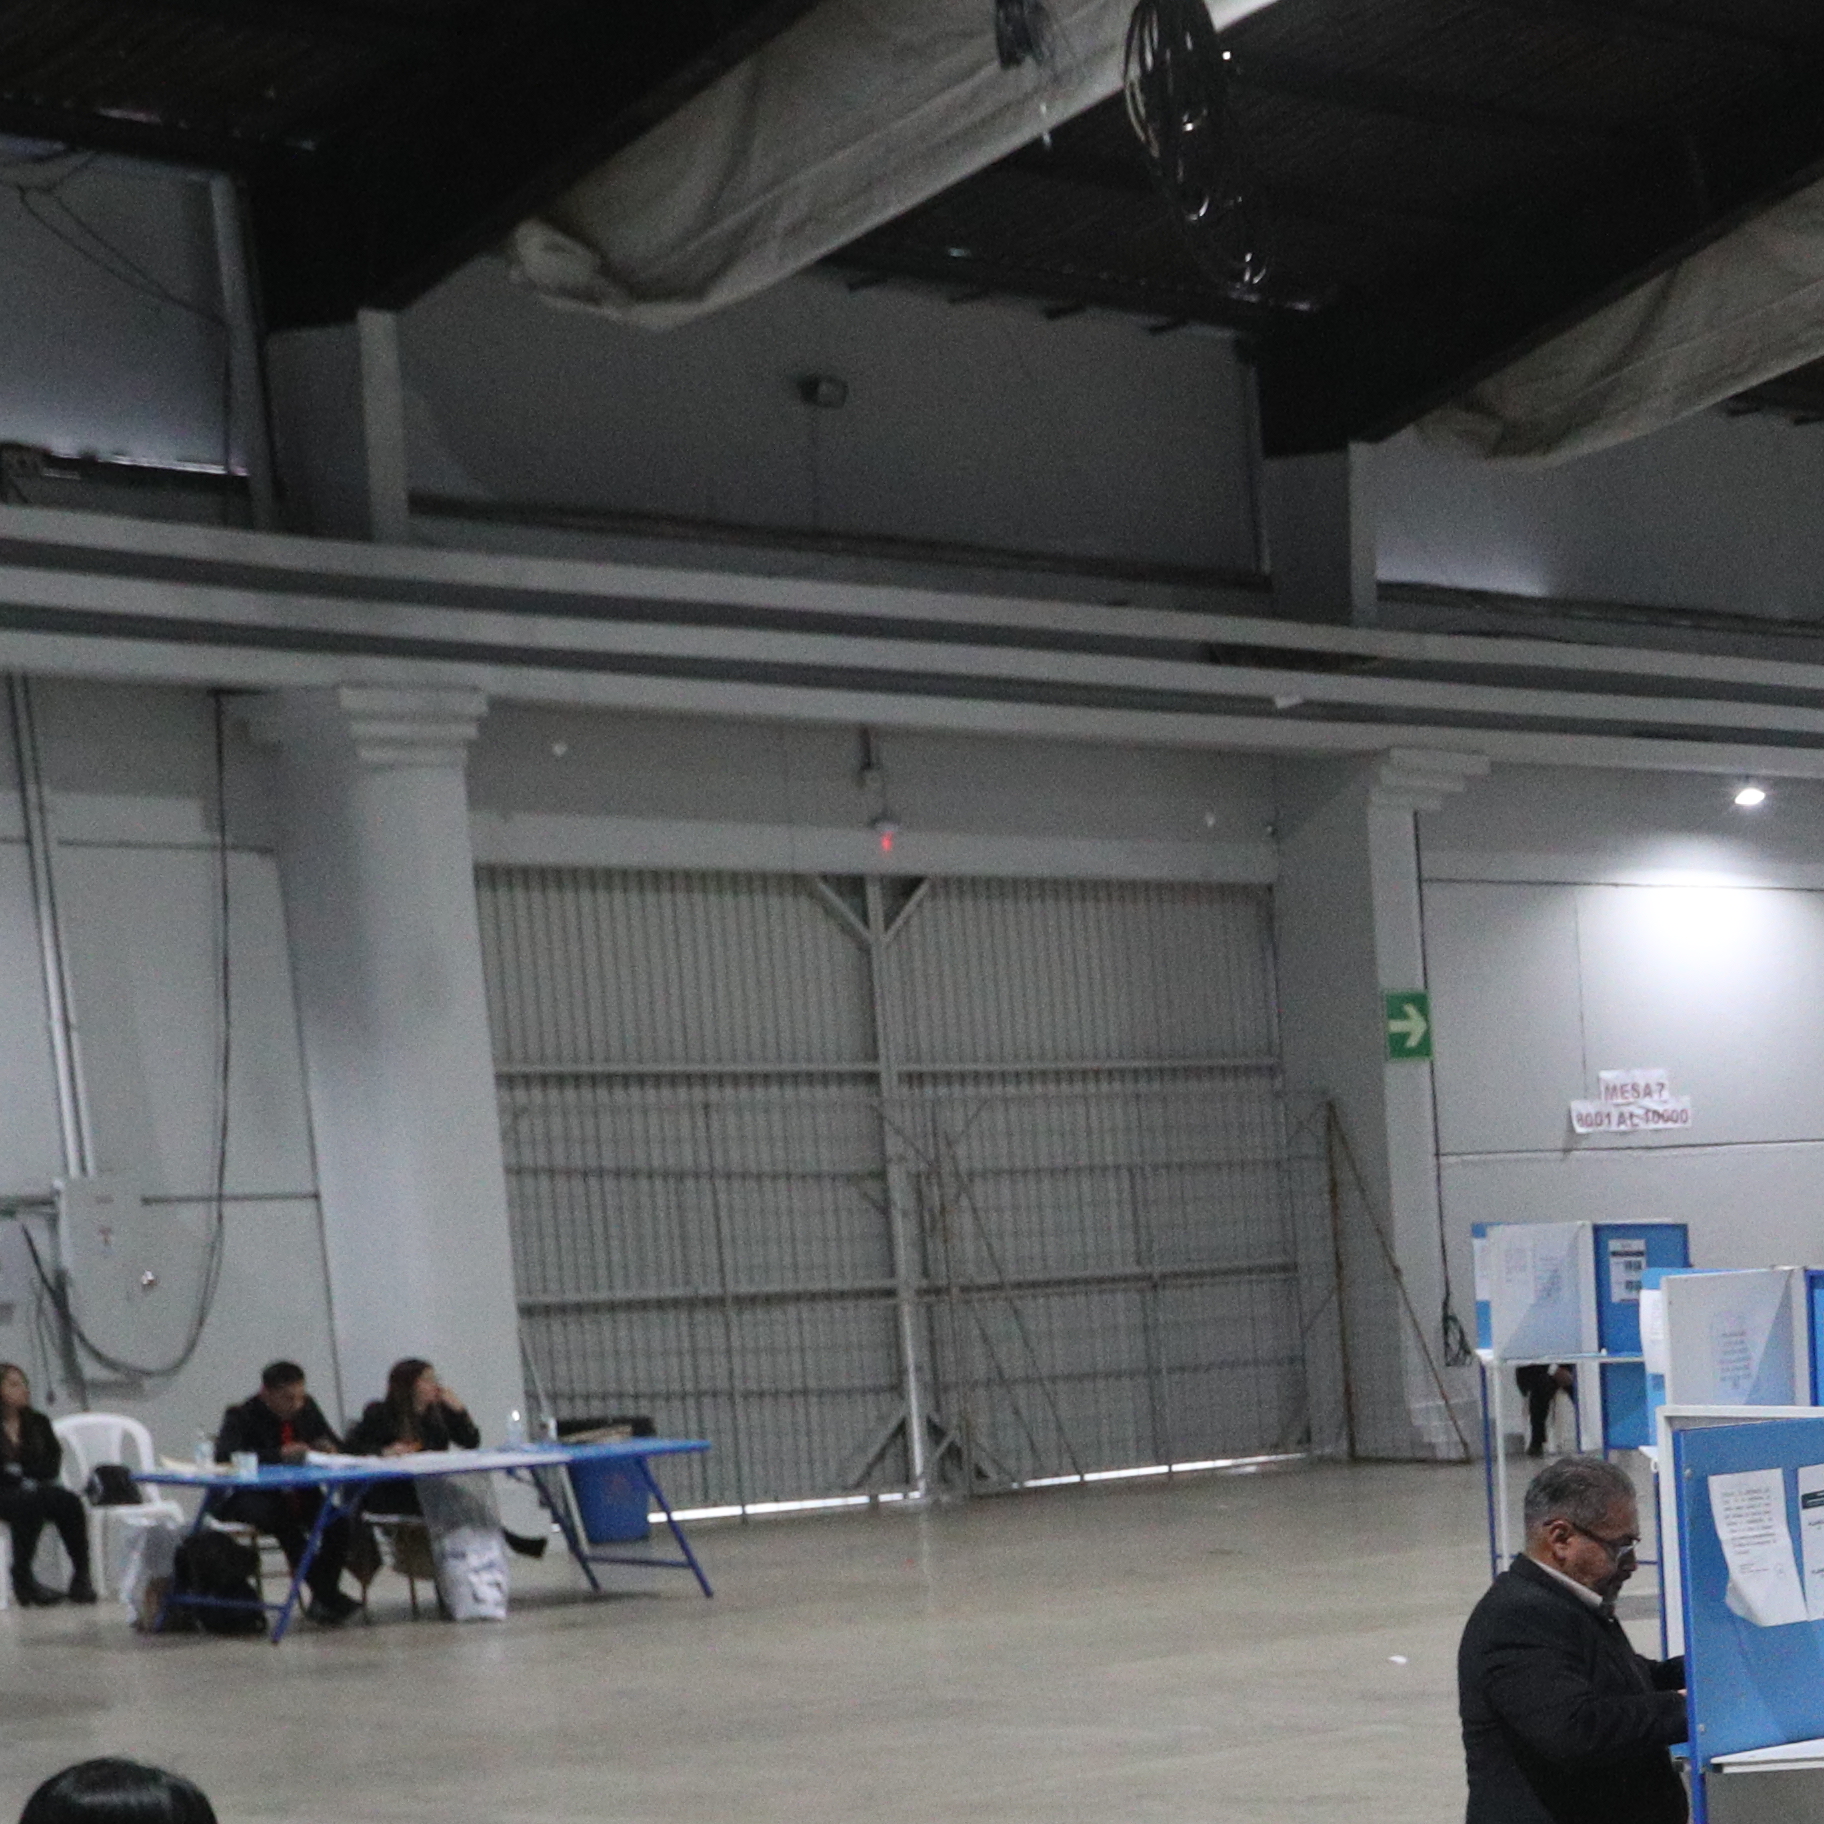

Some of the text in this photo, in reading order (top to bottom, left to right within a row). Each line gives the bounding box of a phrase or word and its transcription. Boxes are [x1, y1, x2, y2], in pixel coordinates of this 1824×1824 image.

[1604, 1082, 1666, 1100] MESA 7
[1576, 1110, 1612, 1128] 8001
[1617, 1110, 1640, 1127] AL
